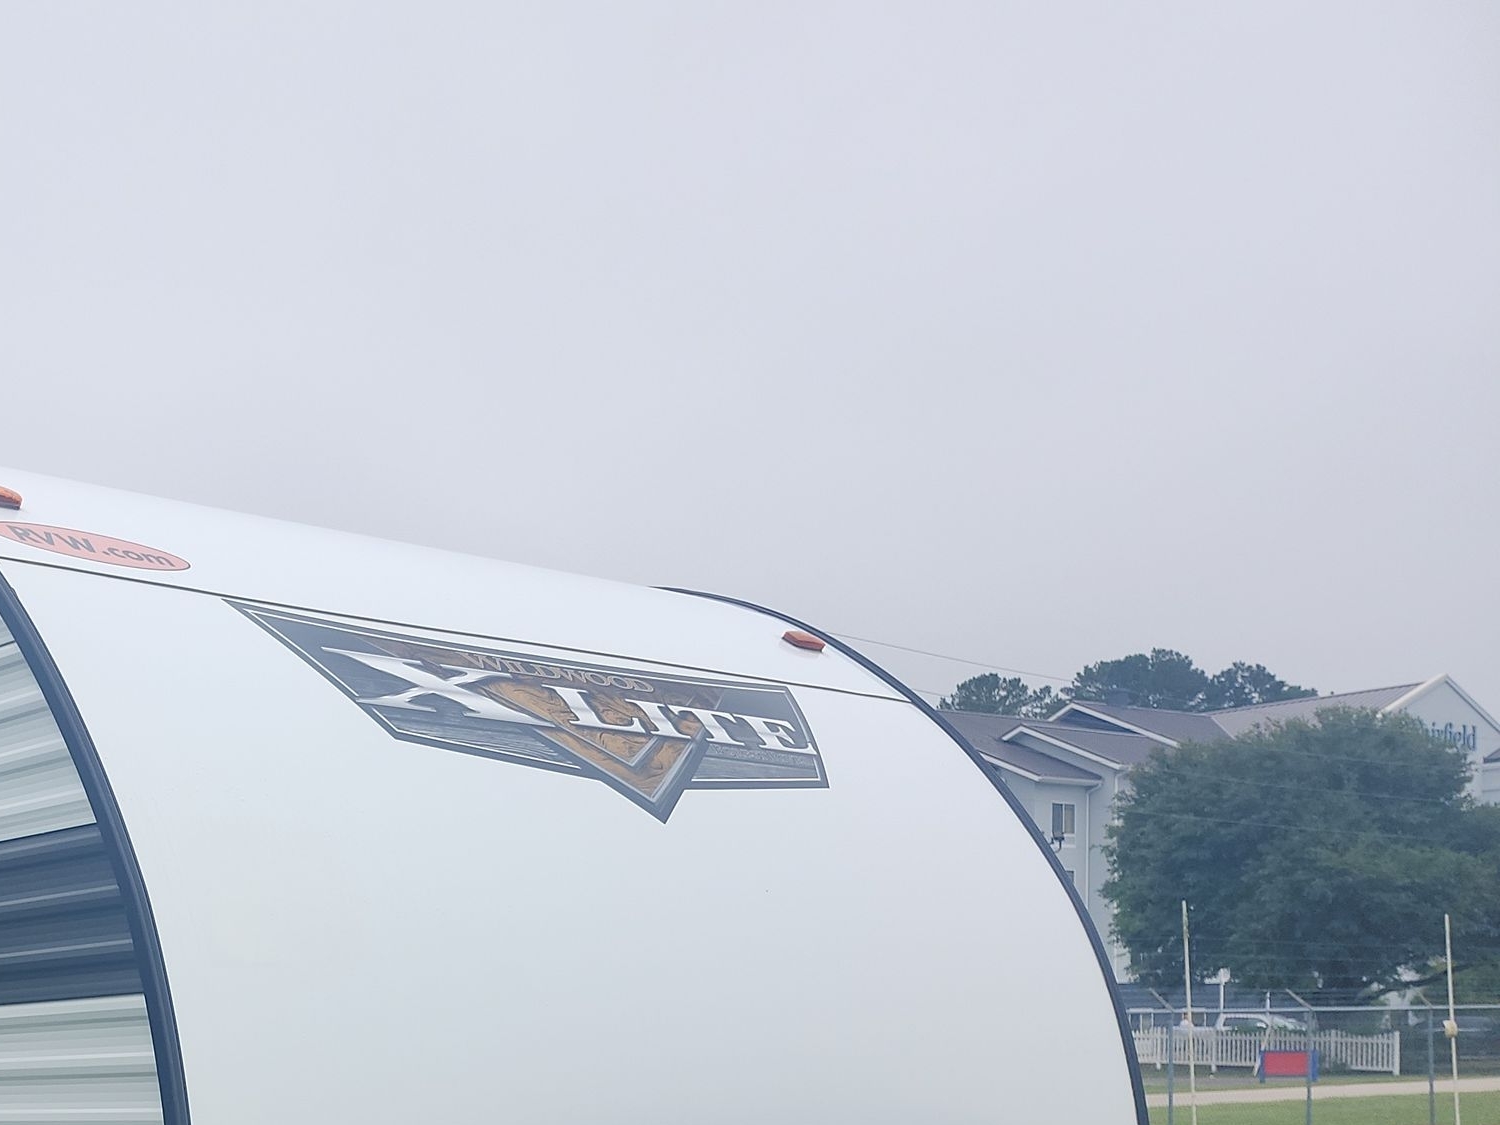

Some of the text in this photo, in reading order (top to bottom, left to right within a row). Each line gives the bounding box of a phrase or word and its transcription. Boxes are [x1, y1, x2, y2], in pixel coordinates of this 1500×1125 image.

[7, 525, 176, 568] RVW.com
[458, 652, 654, 692] WILDWOOD
[320, 646, 818, 756] X LITE
